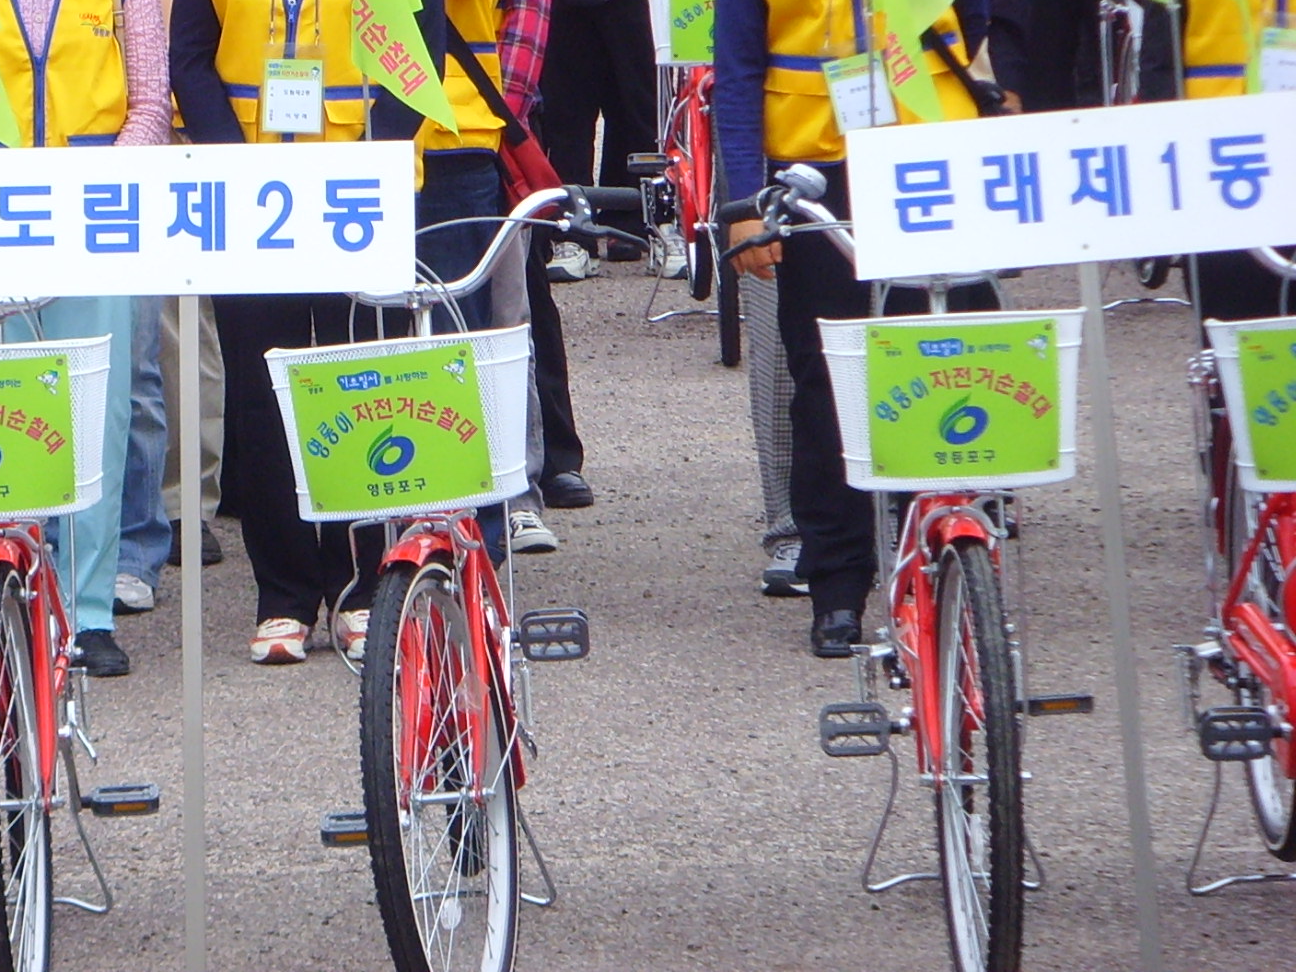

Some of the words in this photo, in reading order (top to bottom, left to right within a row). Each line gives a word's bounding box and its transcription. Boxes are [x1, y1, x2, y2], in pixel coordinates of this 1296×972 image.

[893, 134, 1271, 233] 문래제1동
[929, 367, 1053, 419] 자전거순찰대
[352, 397, 478, 444] 자전거순찰대
[934, 450, 996, 465] 영등포구
[367, 478, 426, 497] 영등포구
